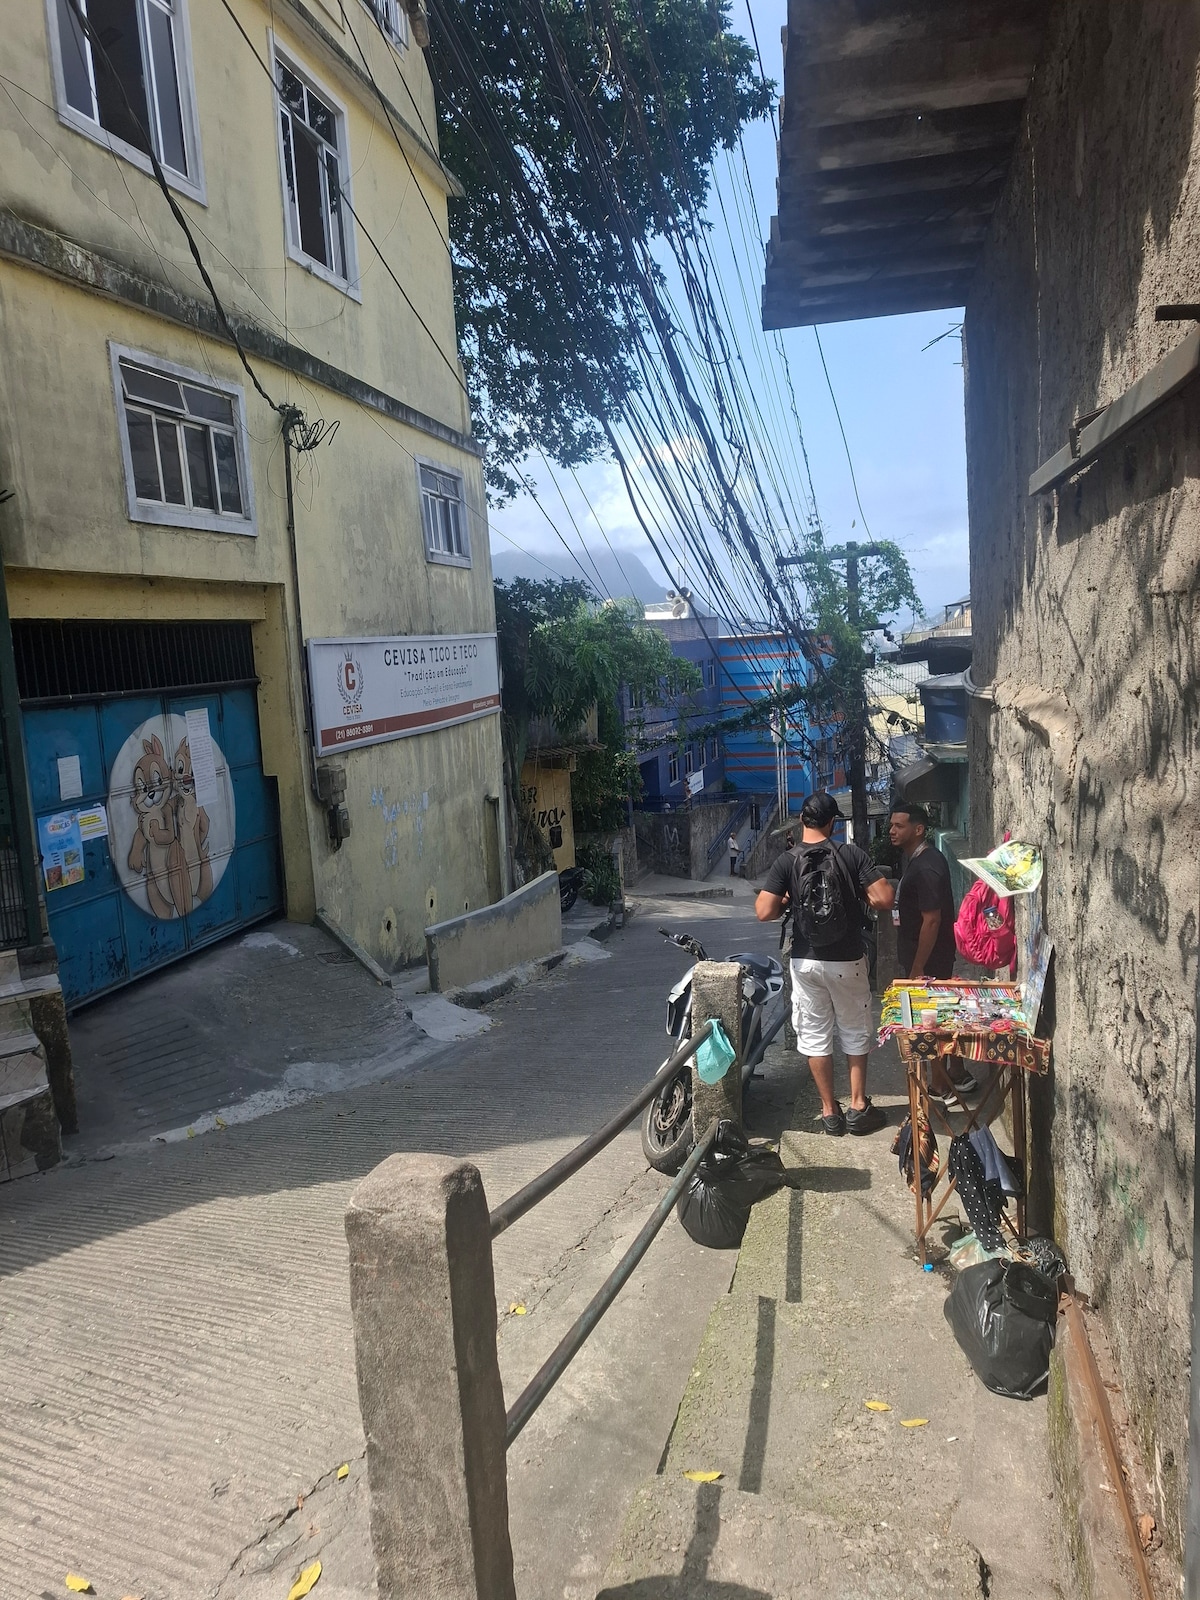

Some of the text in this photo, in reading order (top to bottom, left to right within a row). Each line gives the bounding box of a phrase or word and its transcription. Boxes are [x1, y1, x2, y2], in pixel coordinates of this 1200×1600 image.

[384, 644, 478, 666] CEVISA TICO E TECO
[437, 670, 444, 678] em
[400, 687, 423, 699] Educação
[343, 704, 363, 715] CEVISA
[335, 729, 346, 740] (21)
